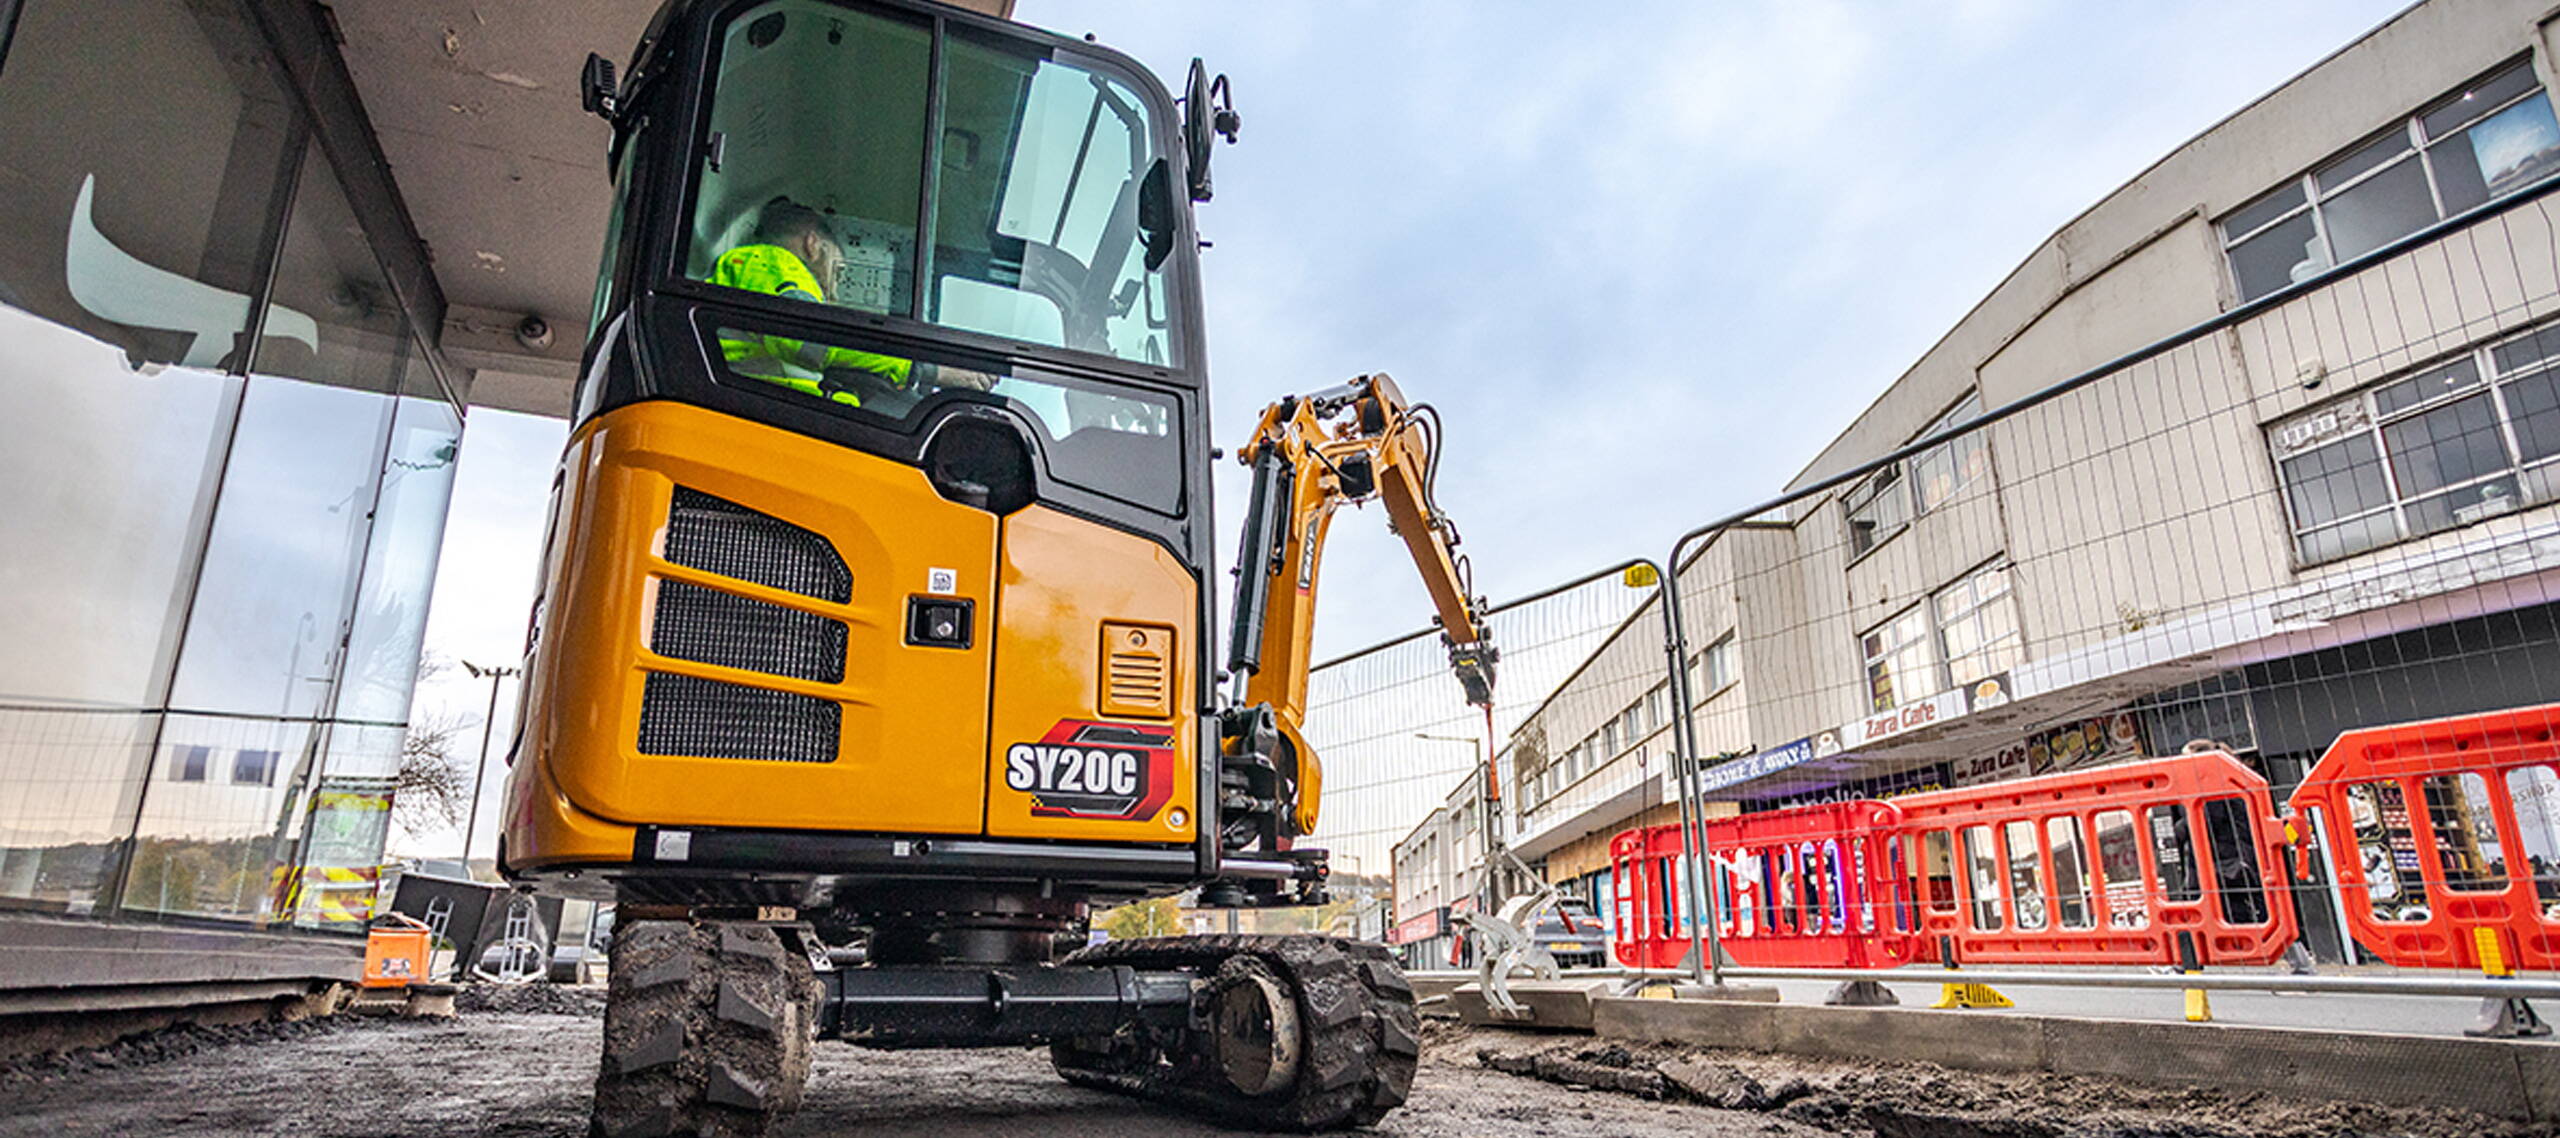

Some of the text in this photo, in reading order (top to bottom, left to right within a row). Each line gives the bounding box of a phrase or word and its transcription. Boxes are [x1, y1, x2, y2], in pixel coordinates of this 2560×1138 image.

[1865, 701, 1936, 740] Zara Cafe
[1008, 744, 1137, 796] SY20C
[1970, 756, 1996, 777] Zara
